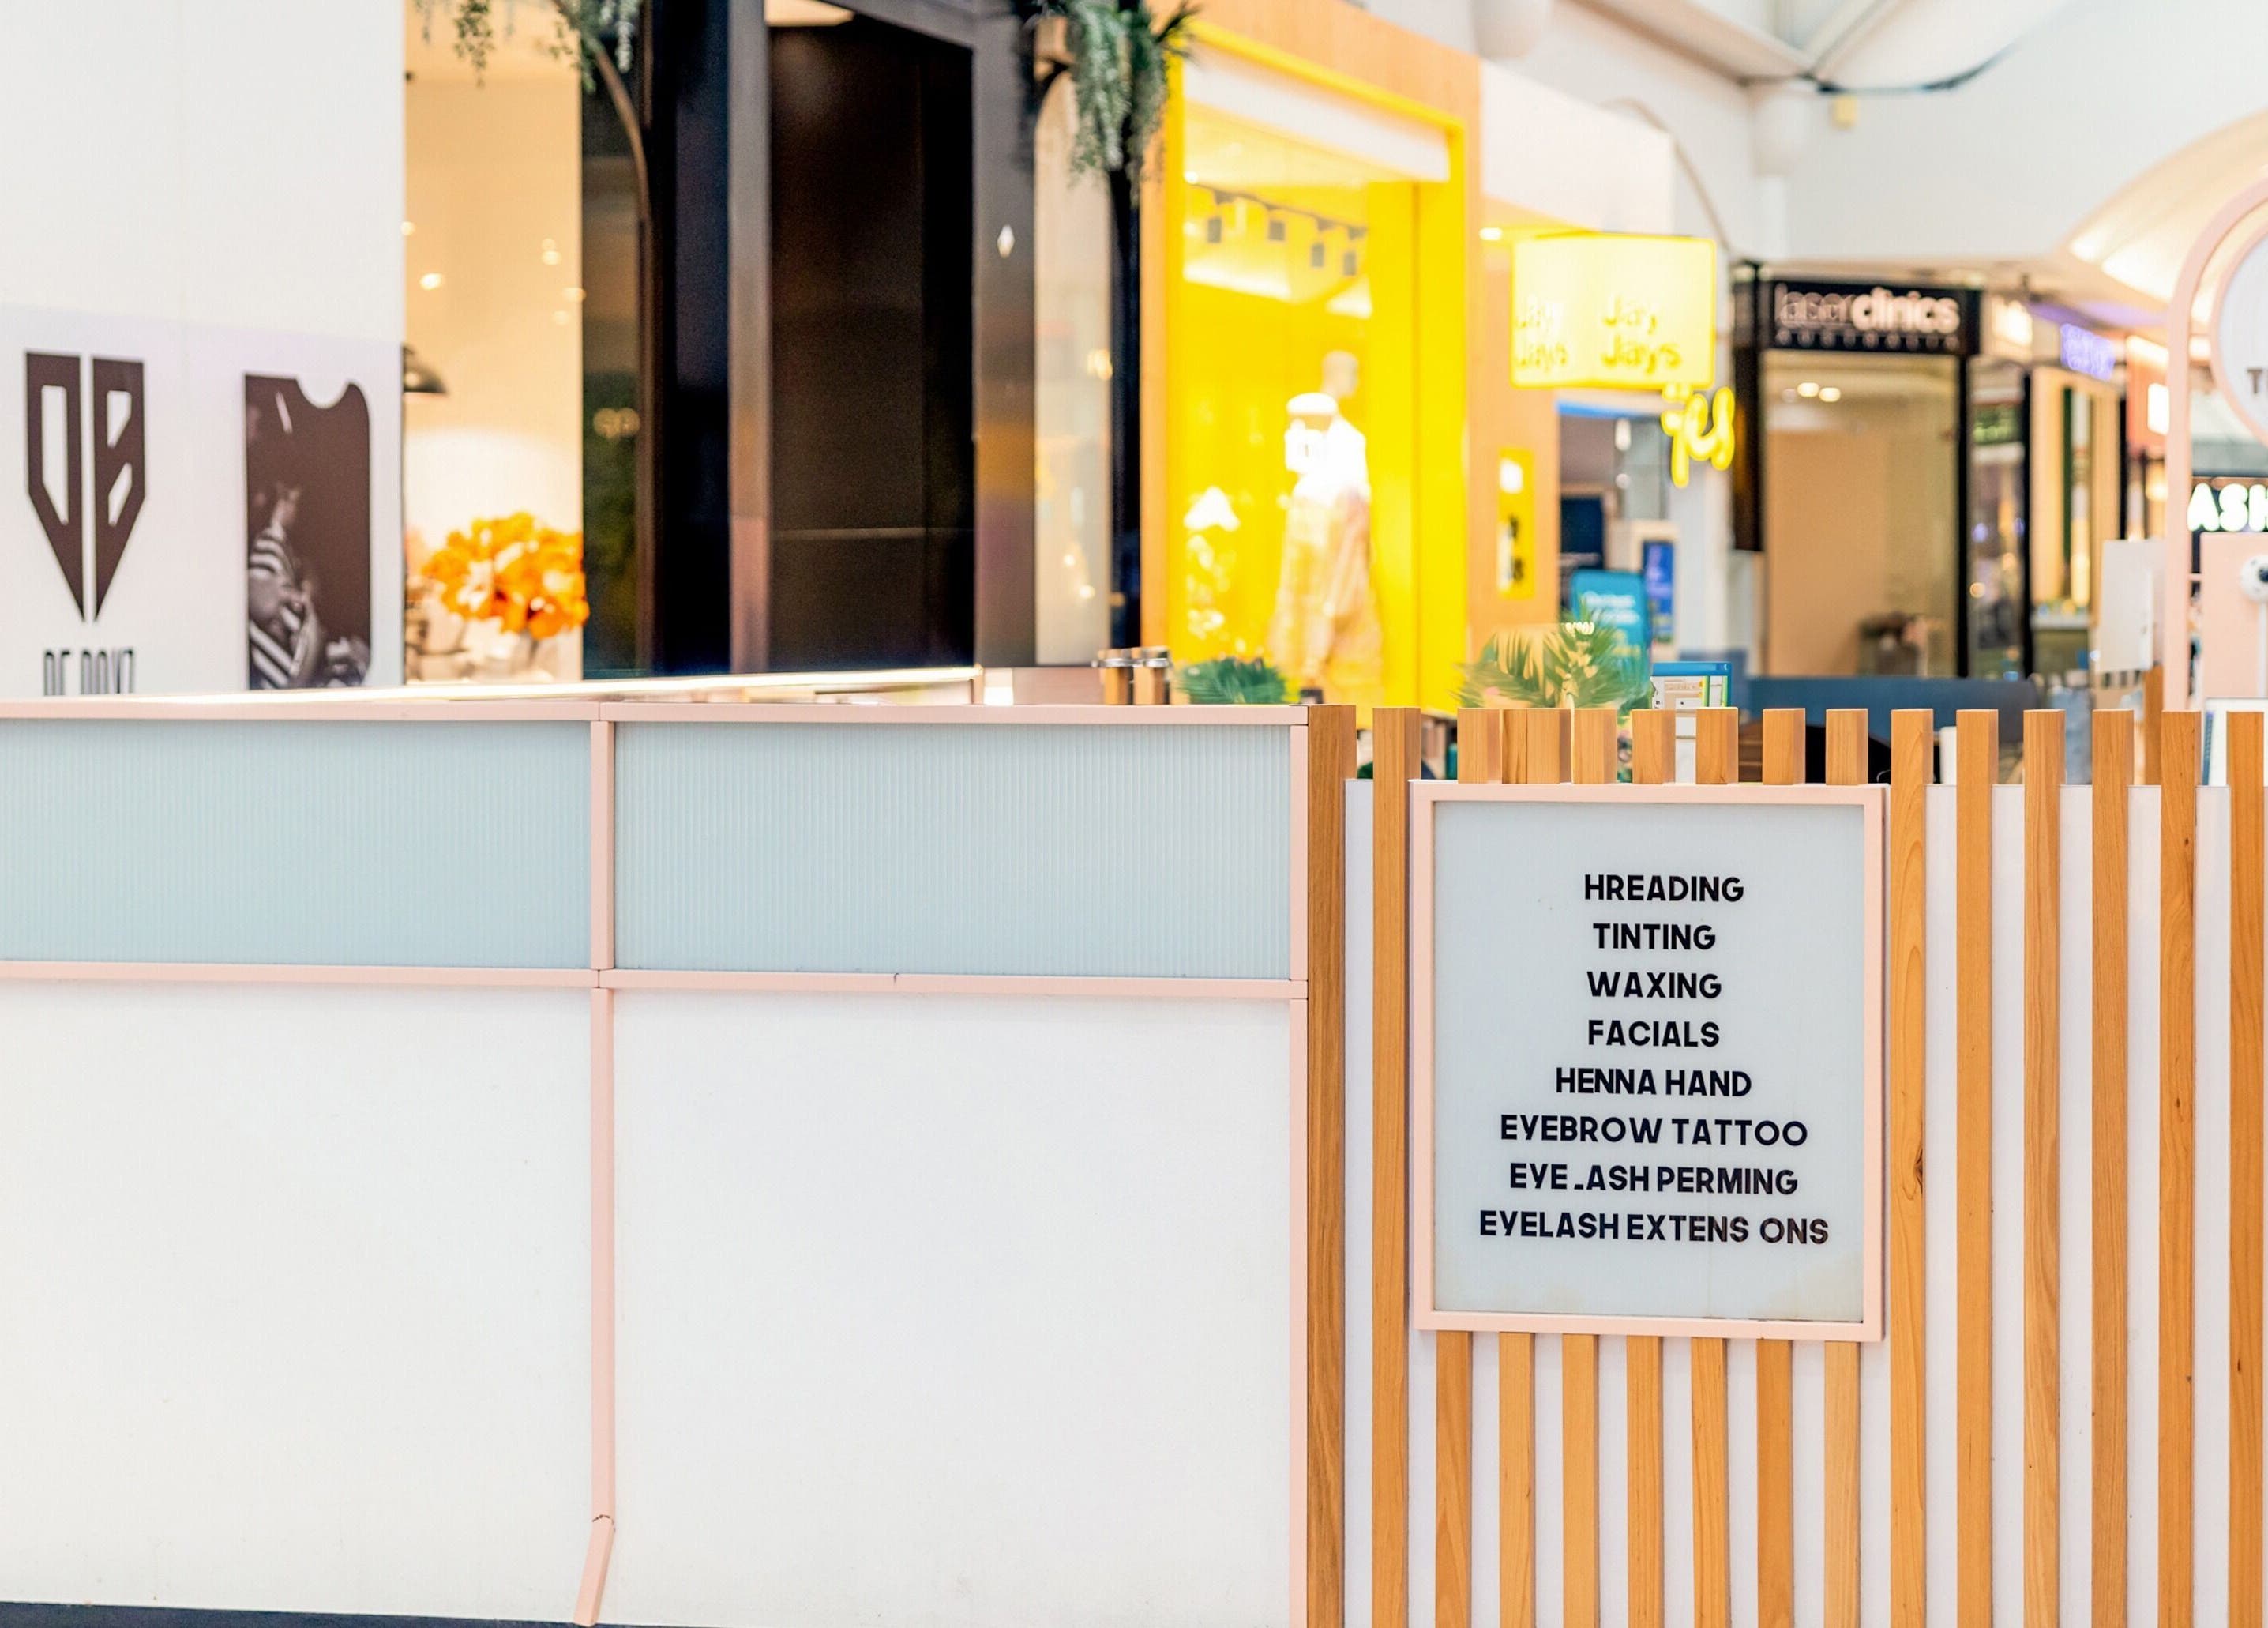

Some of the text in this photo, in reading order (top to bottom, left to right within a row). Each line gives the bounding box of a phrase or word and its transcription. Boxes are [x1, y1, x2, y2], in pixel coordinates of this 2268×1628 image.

[1601, 294, 1662, 337] Jay
[1599, 333, 1683, 376] Jays
[1584, 874, 1744, 903] HREADING
[1592, 923, 1716, 950] TINTING
[1586, 971, 1722, 999] WAXING
[1588, 1019, 1720, 1048] FACIALS
[1556, 1066, 1752, 1097] HENNA HAND
[1500, 1114, 1808, 1147] EYEBROW TATTOO
[1510, 1162, 1798, 1196] EYEASH PERMING
[1479, 1209, 1619, 1240] EYELASH
